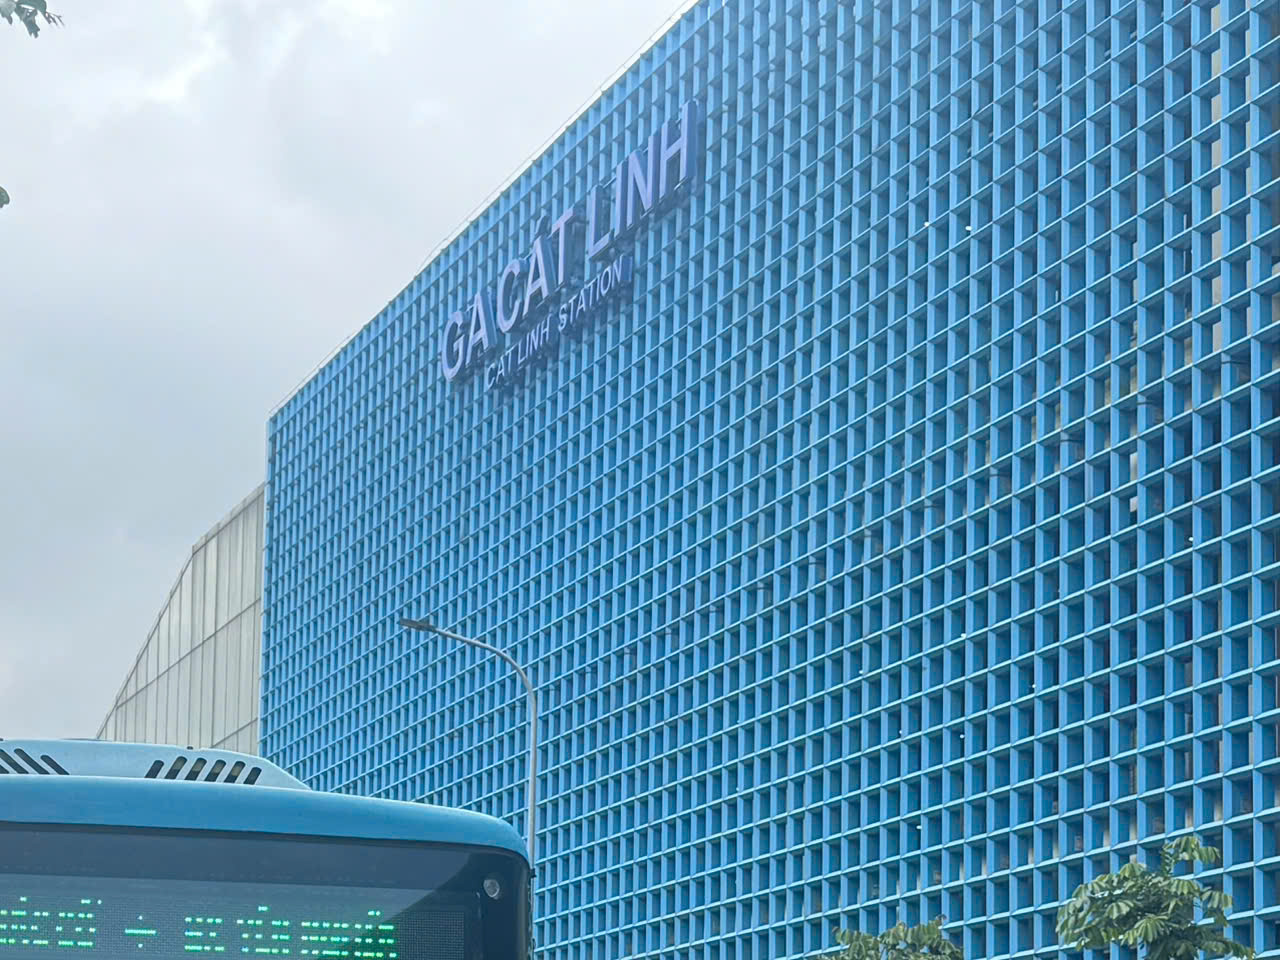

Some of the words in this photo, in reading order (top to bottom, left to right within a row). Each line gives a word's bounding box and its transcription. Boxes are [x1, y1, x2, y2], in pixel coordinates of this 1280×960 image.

[441, 290, 492, 382] GA
[497, 206, 574, 333] CÁT
[588, 100, 697, 260] LINH
[486, 344, 517, 389] CAT
[517, 313, 552, 365] LINH
[558, 253, 625, 333] STATION
